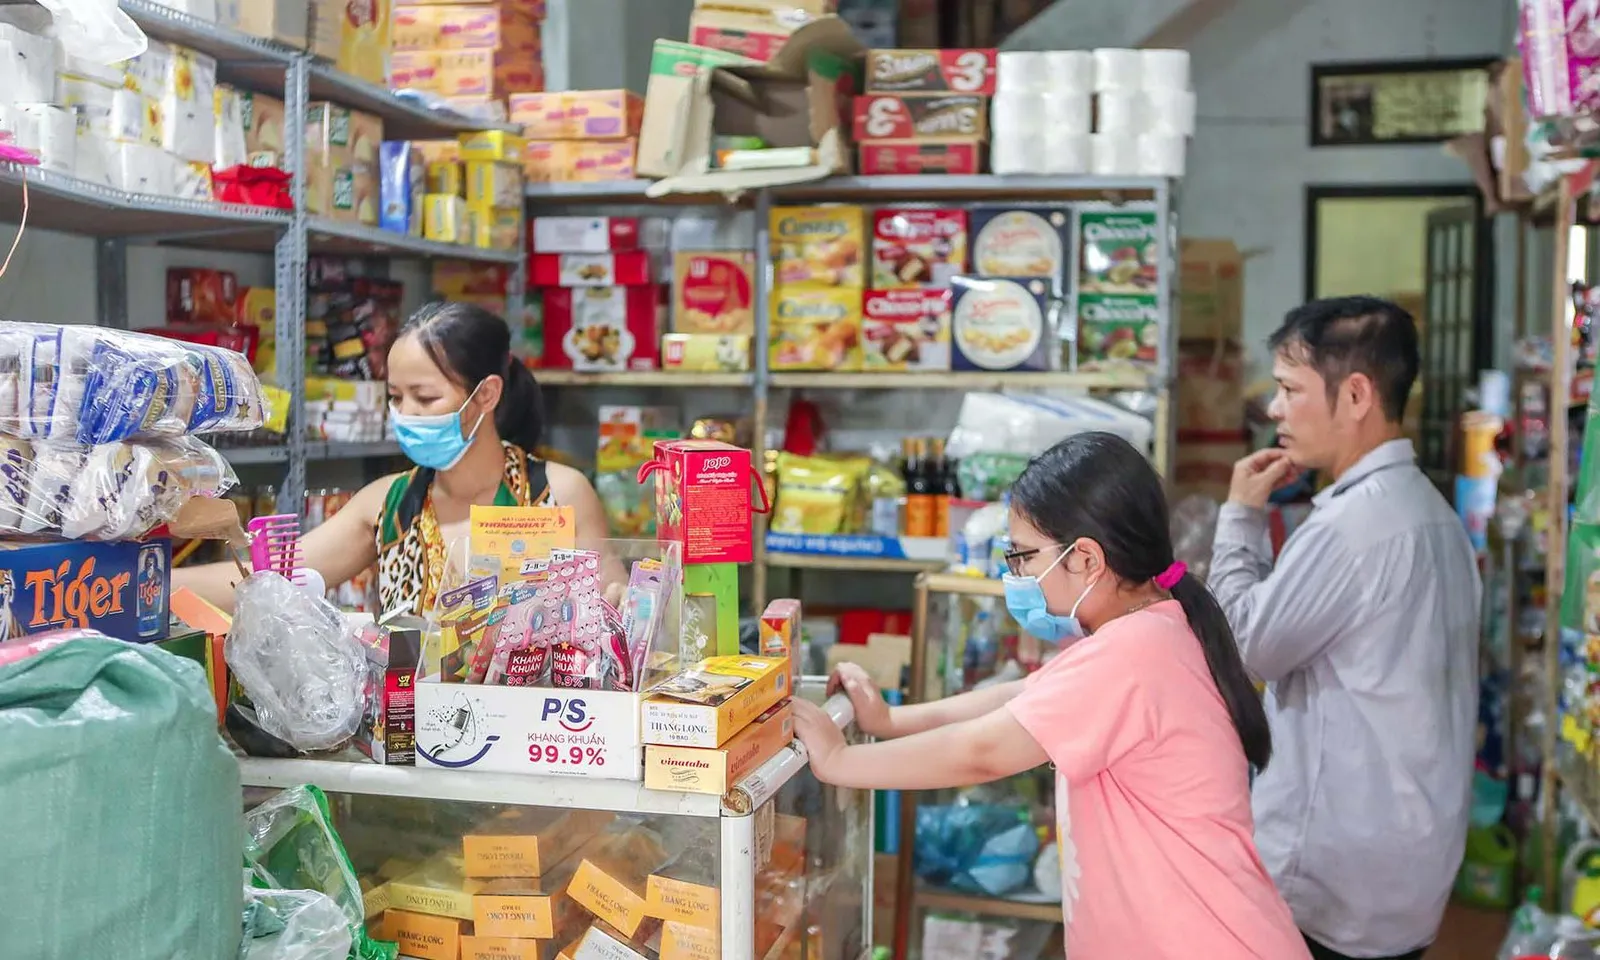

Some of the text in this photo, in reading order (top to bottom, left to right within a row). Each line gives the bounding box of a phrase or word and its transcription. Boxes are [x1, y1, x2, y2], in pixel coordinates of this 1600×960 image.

[702, 456, 731, 472] JOJO
[25, 556, 131, 630] Tiger
[138, 580, 161, 607] Tiger
[541, 698, 587, 723] P/S
[682, 723, 708, 733] LONG
[528, 732, 565, 744] KHÁNG
[660, 757, 710, 769] vinataba
[423, 933, 444, 946] LONG
